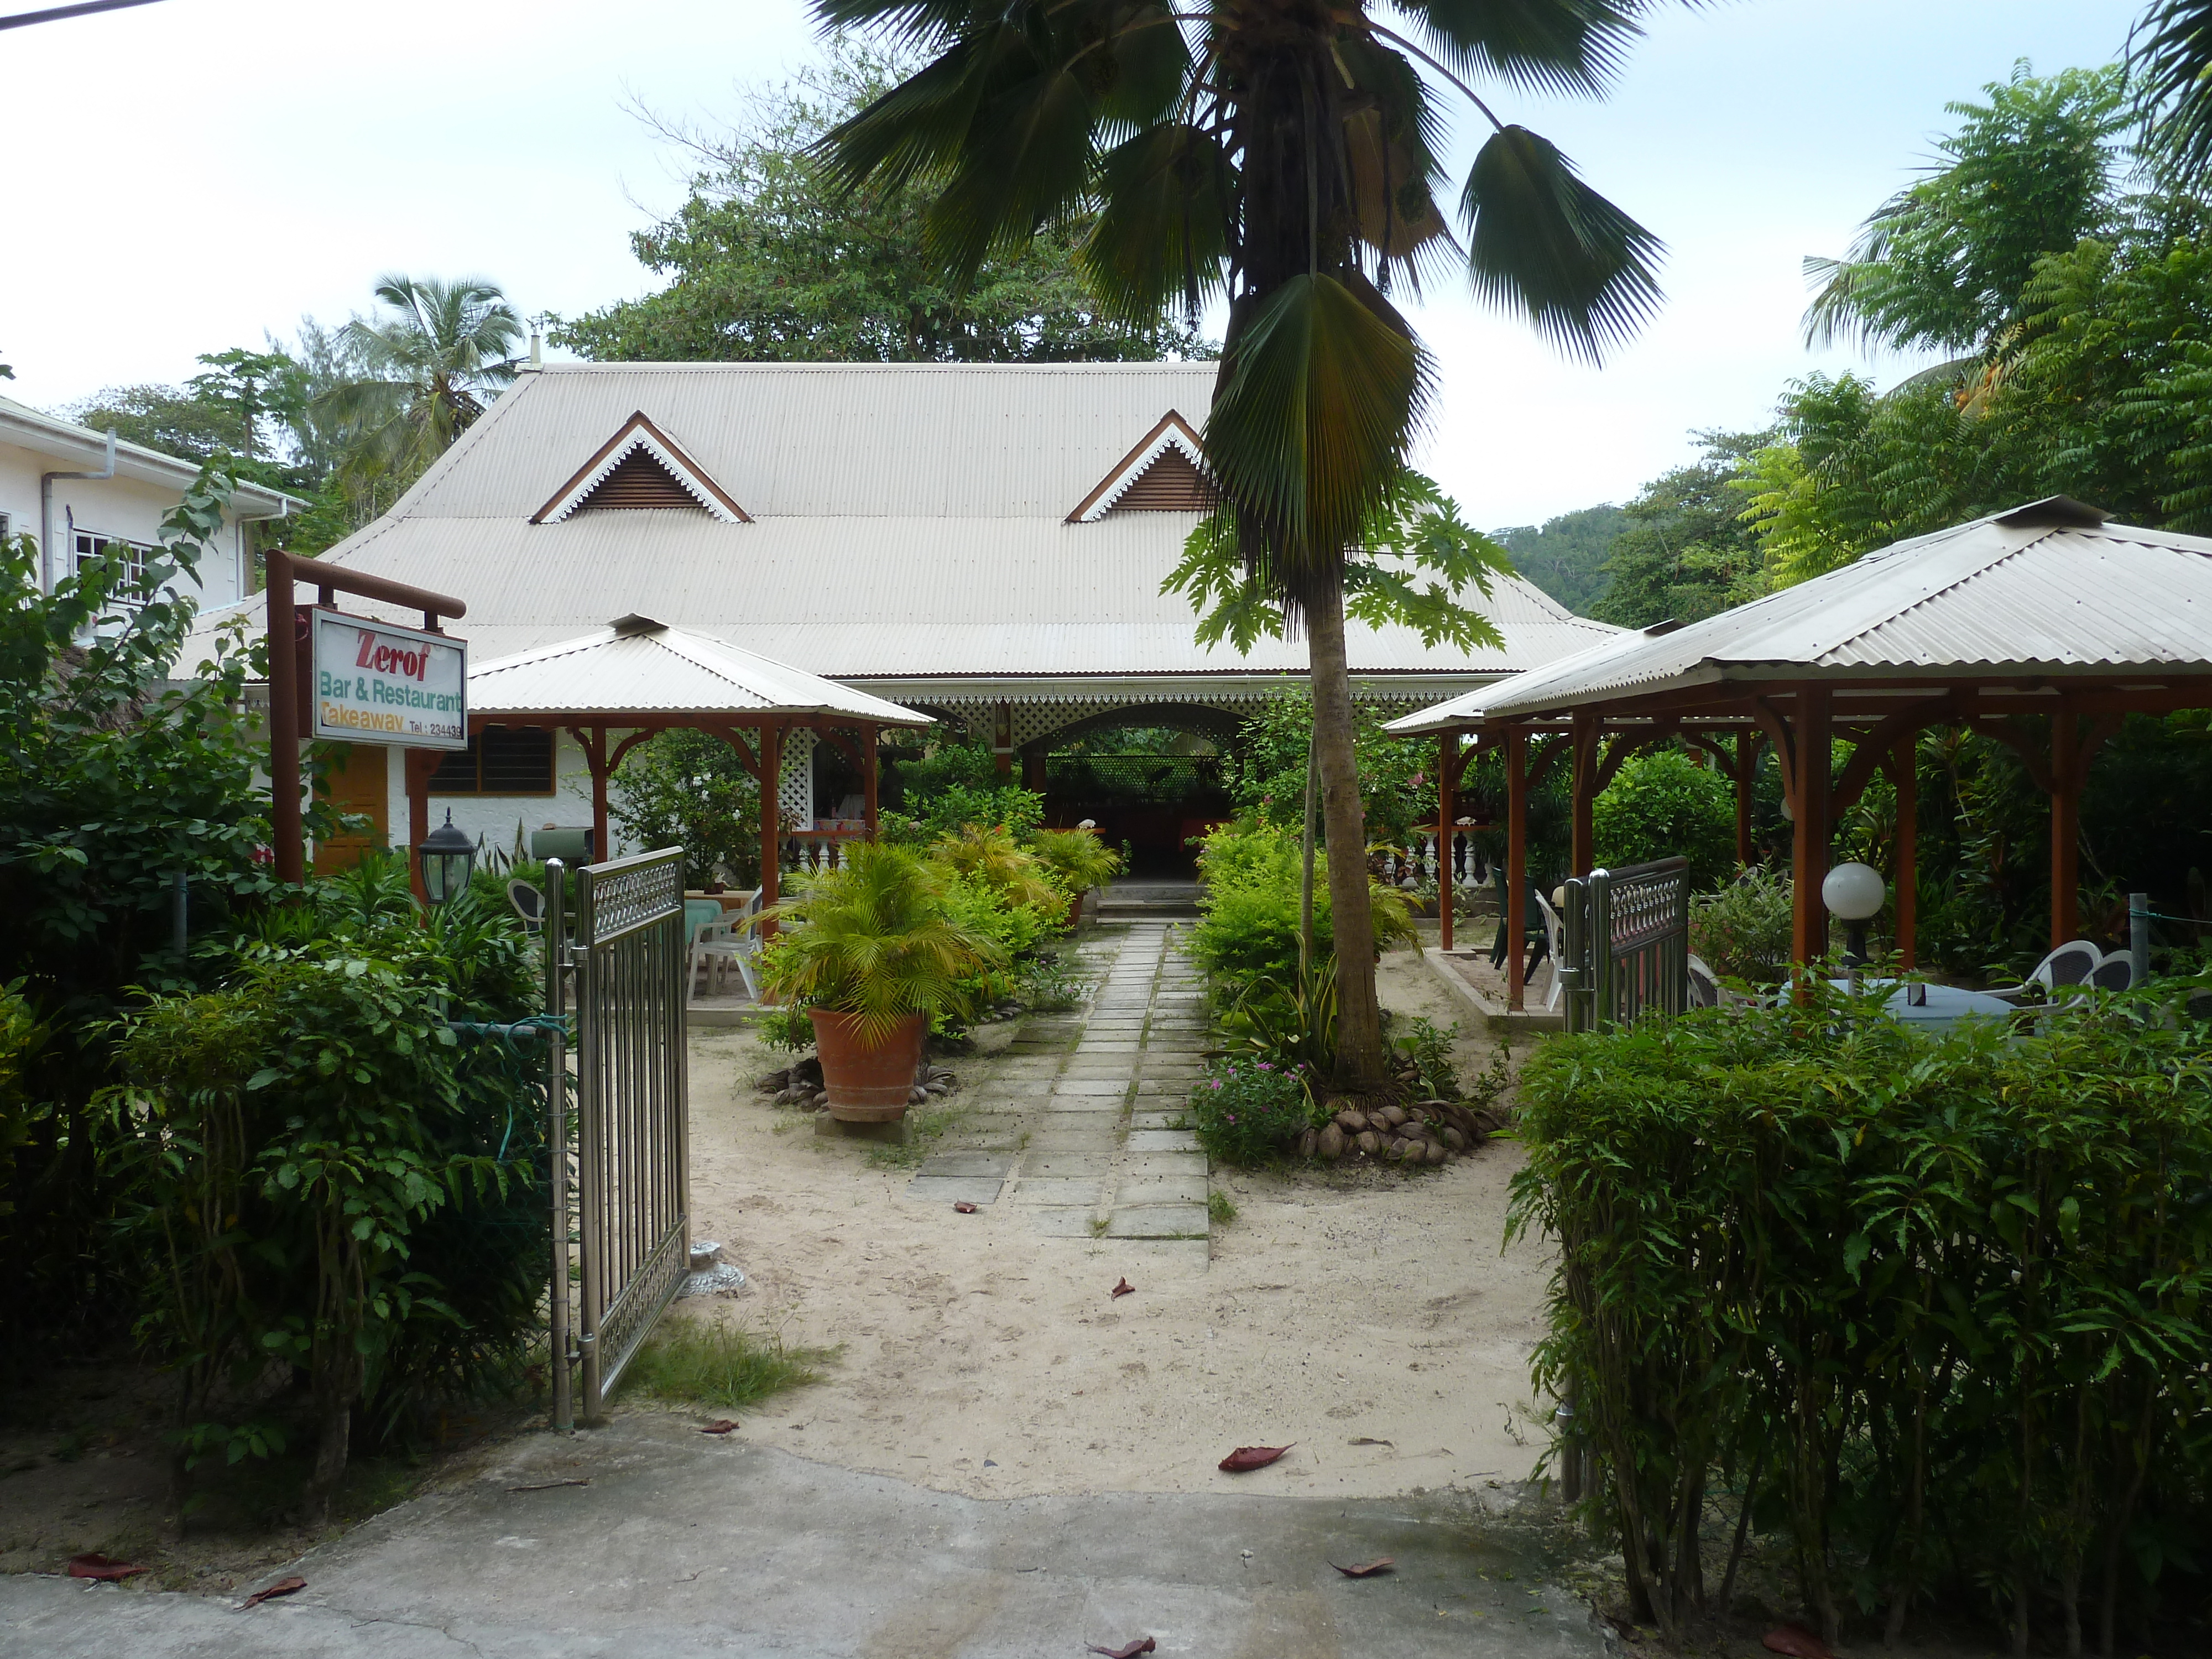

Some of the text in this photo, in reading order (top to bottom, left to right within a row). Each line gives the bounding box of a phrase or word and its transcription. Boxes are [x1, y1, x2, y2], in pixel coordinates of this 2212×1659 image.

[356, 630, 431, 681] Zerof
[321, 671, 461, 712] Bar & Restaurant
[430, 723, 461, 737] 234439
